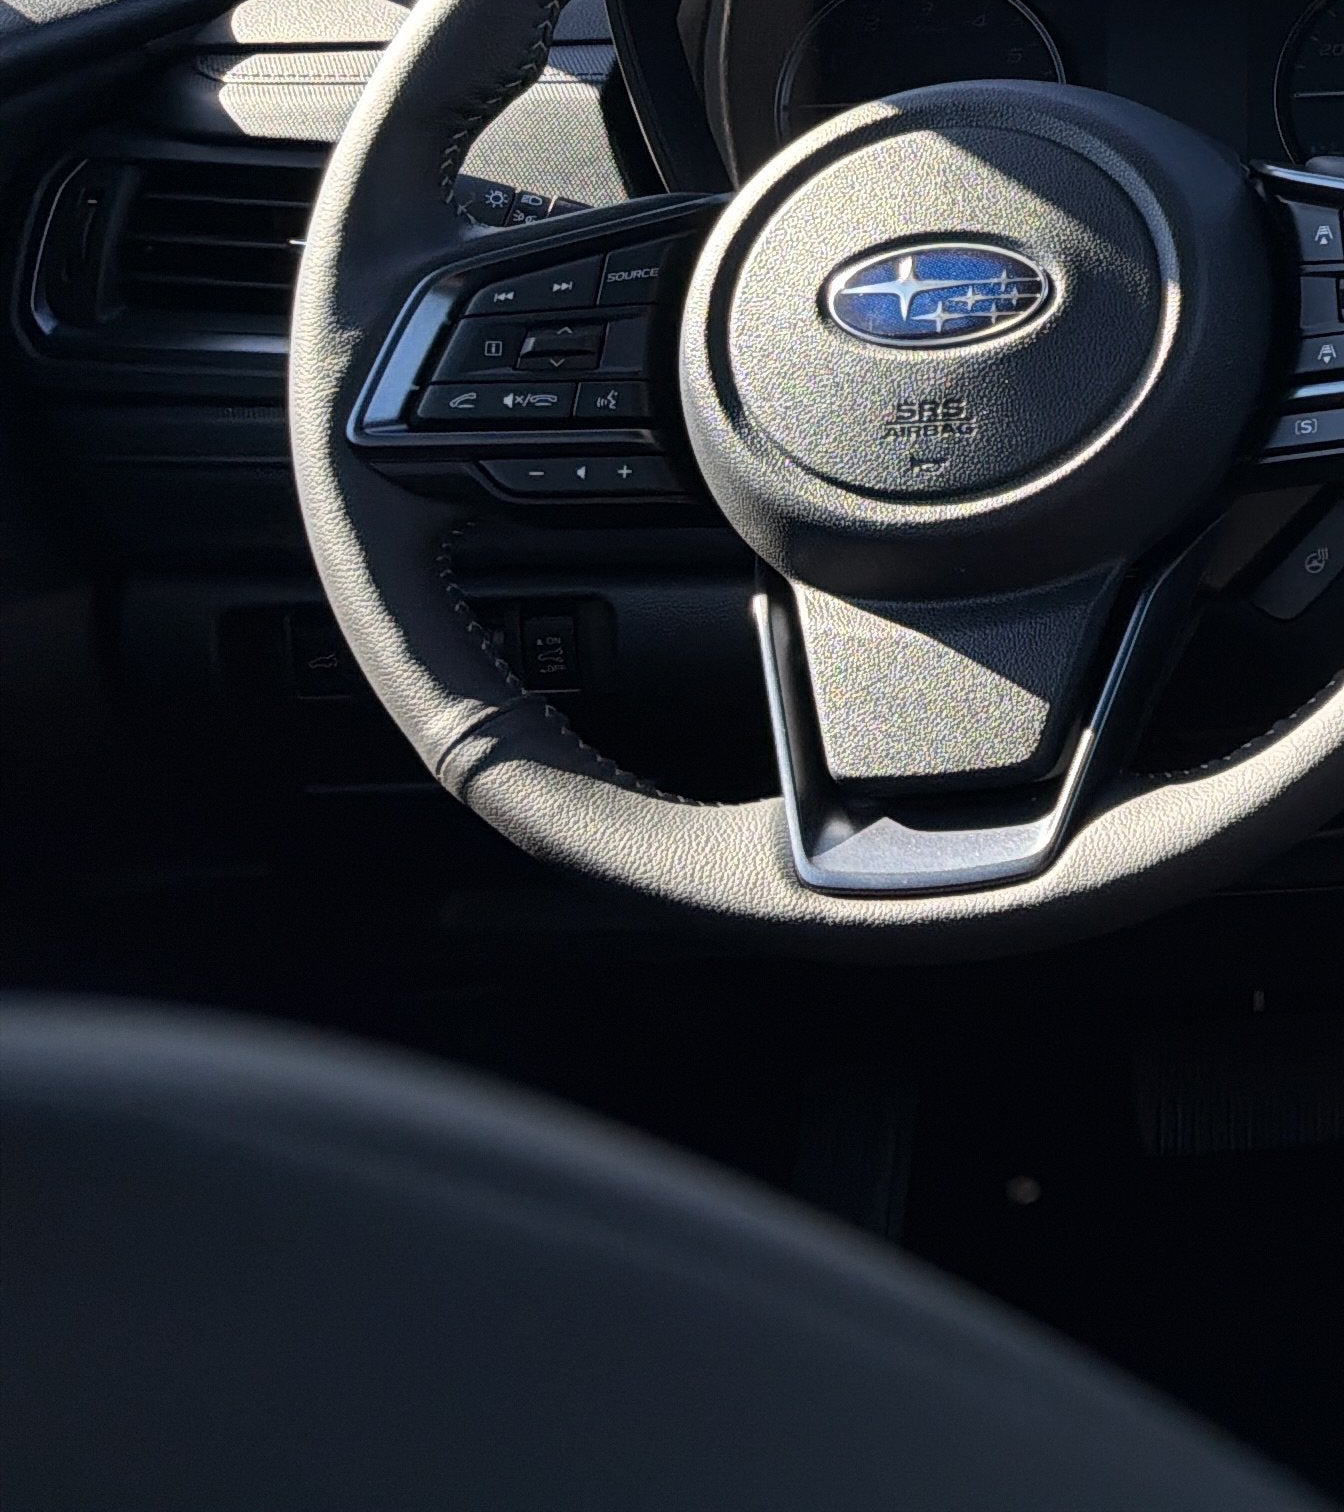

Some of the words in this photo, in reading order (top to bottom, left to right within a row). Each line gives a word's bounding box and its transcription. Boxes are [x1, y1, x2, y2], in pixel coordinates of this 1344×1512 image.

[606, 268, 660, 283] SOURCE
[897, 399, 968, 423] SRS
[883, 423, 978, 439] AIRBAG
